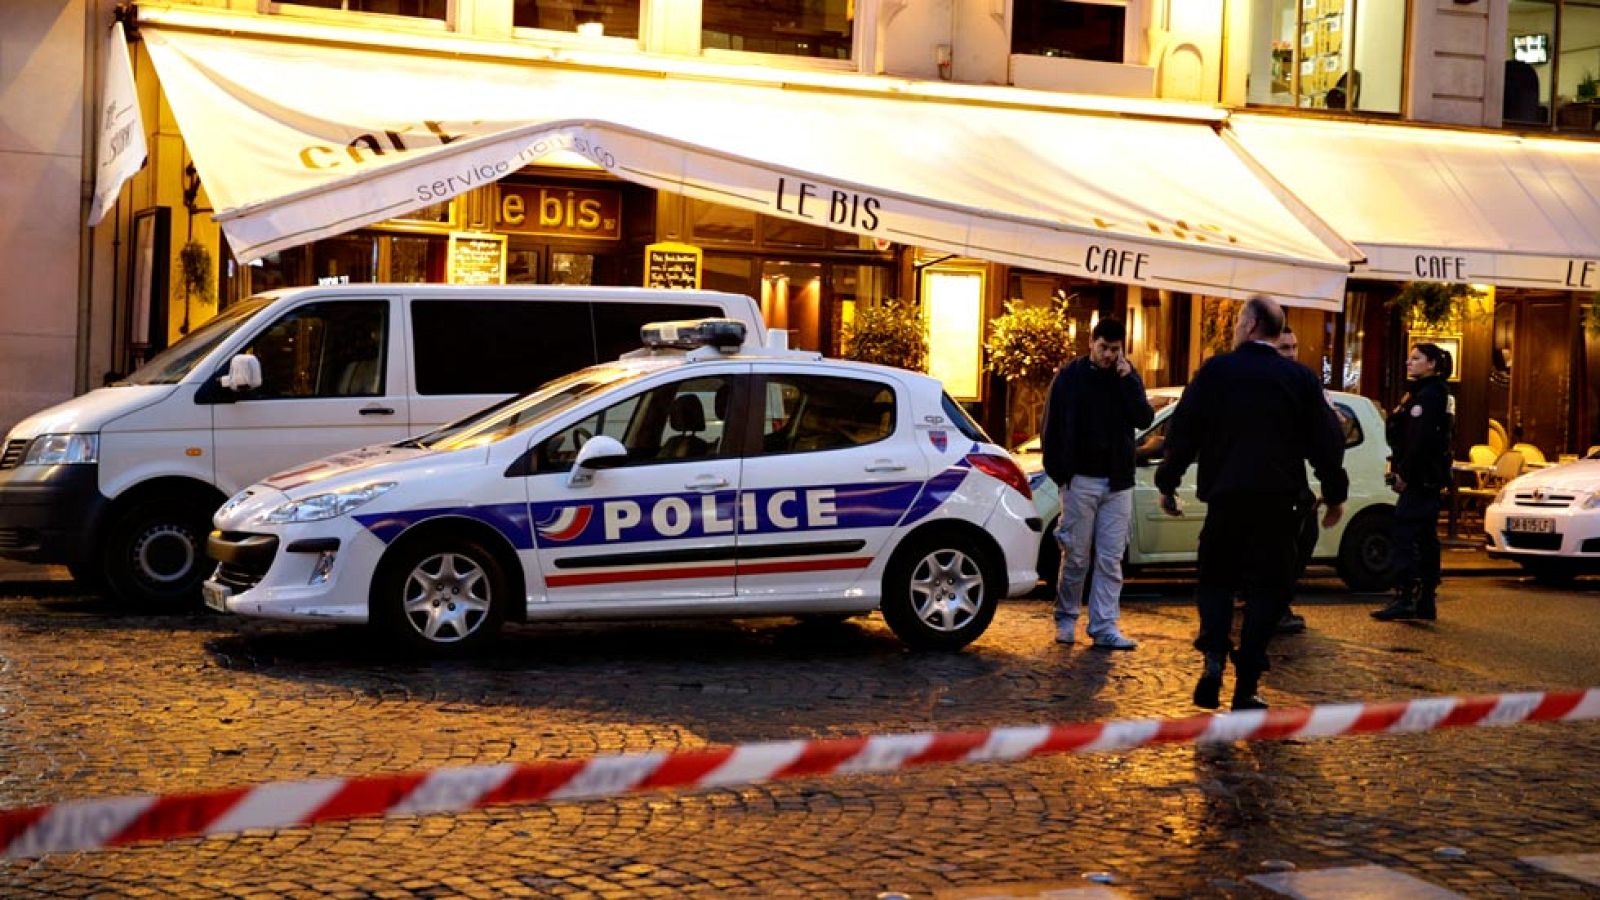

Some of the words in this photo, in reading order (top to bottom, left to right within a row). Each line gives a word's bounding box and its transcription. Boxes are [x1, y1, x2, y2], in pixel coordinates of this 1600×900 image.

[776, 177, 816, 219] LE
[829, 189, 881, 231] BIS
[1085, 244, 1150, 281] CAFE
[1414, 254, 1467, 280] CAFE
[1564, 259, 1597, 288] LE
[603, 488, 839, 541] POLICE
